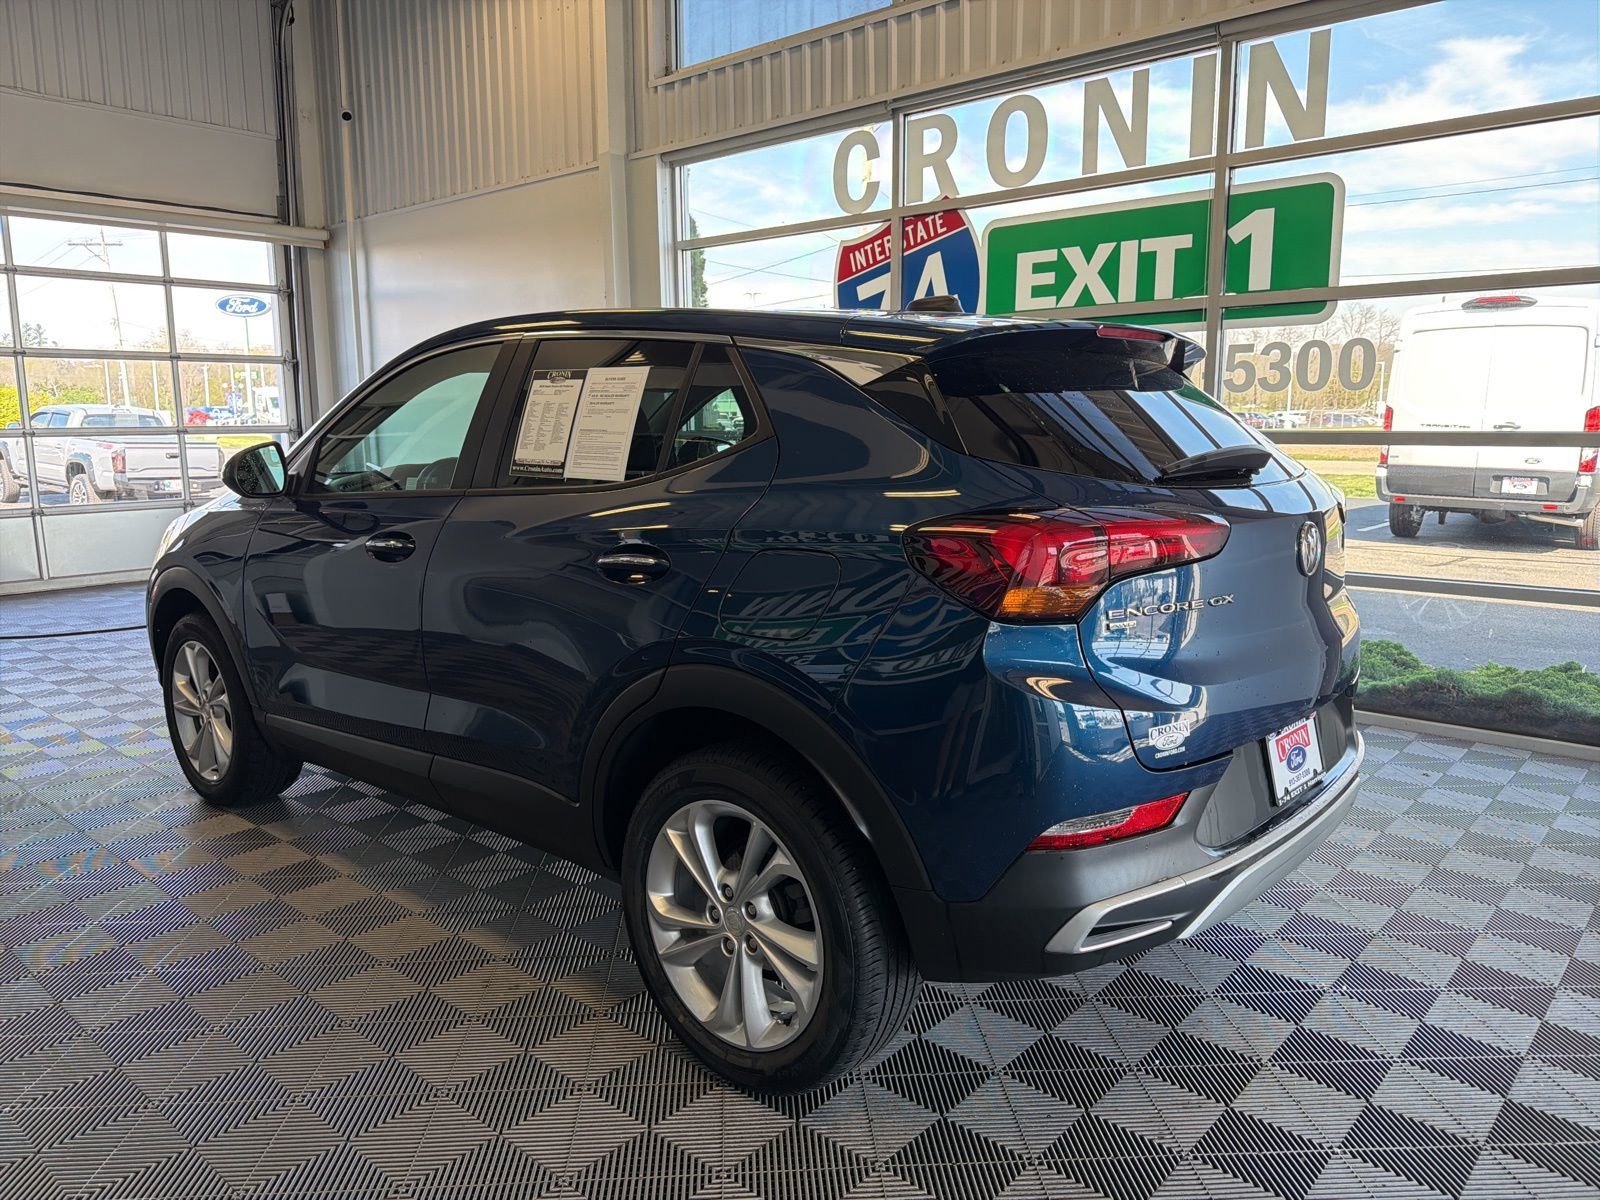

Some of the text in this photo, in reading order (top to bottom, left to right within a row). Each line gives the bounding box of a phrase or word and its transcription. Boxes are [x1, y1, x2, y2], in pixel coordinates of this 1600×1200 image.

[832, 29, 1331, 214] CRONIN
[850, 212, 947, 272] INTERTATE
[1015, 207, 1275, 311] EXIT 1
[226, 297, 258, 313] Ford
[1106, 594, 1234, 620] ENCORE GX
[1150, 720, 1190, 741] CRONIN
[1278, 728, 1311, 760] CRONIN
